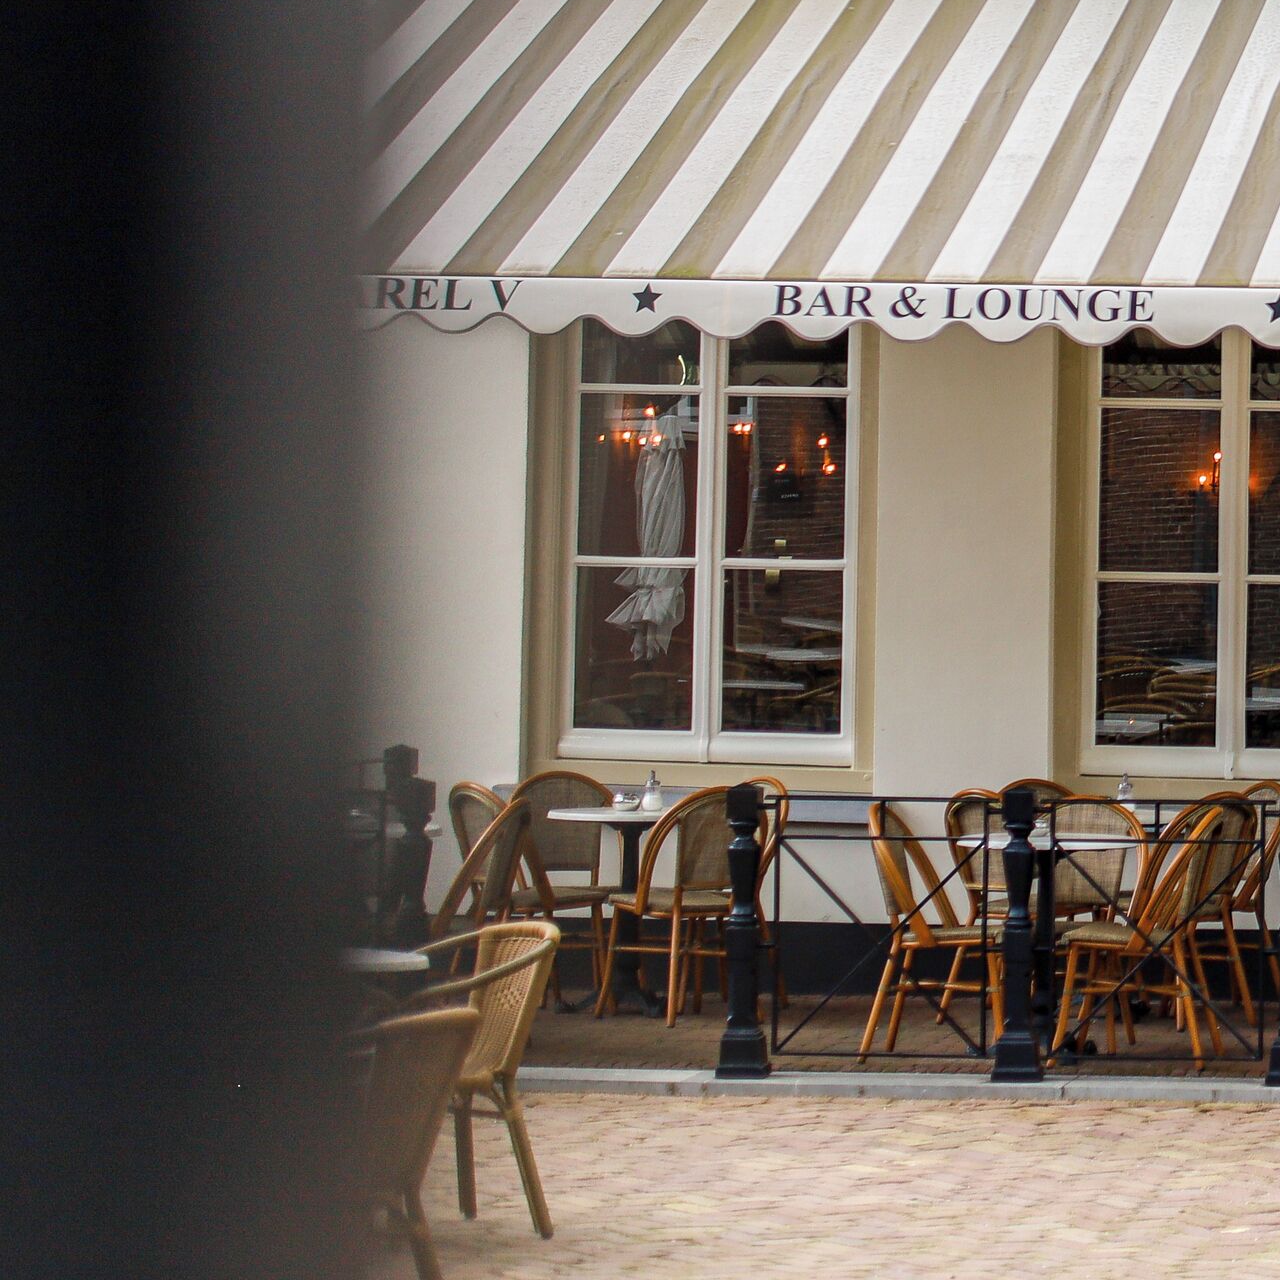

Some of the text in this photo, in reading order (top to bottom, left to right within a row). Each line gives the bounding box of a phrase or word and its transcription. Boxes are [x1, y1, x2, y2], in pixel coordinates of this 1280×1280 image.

[364, 277, 523, 312] REL V
[772, 284, 1154, 323] BAR & LOUNGE
